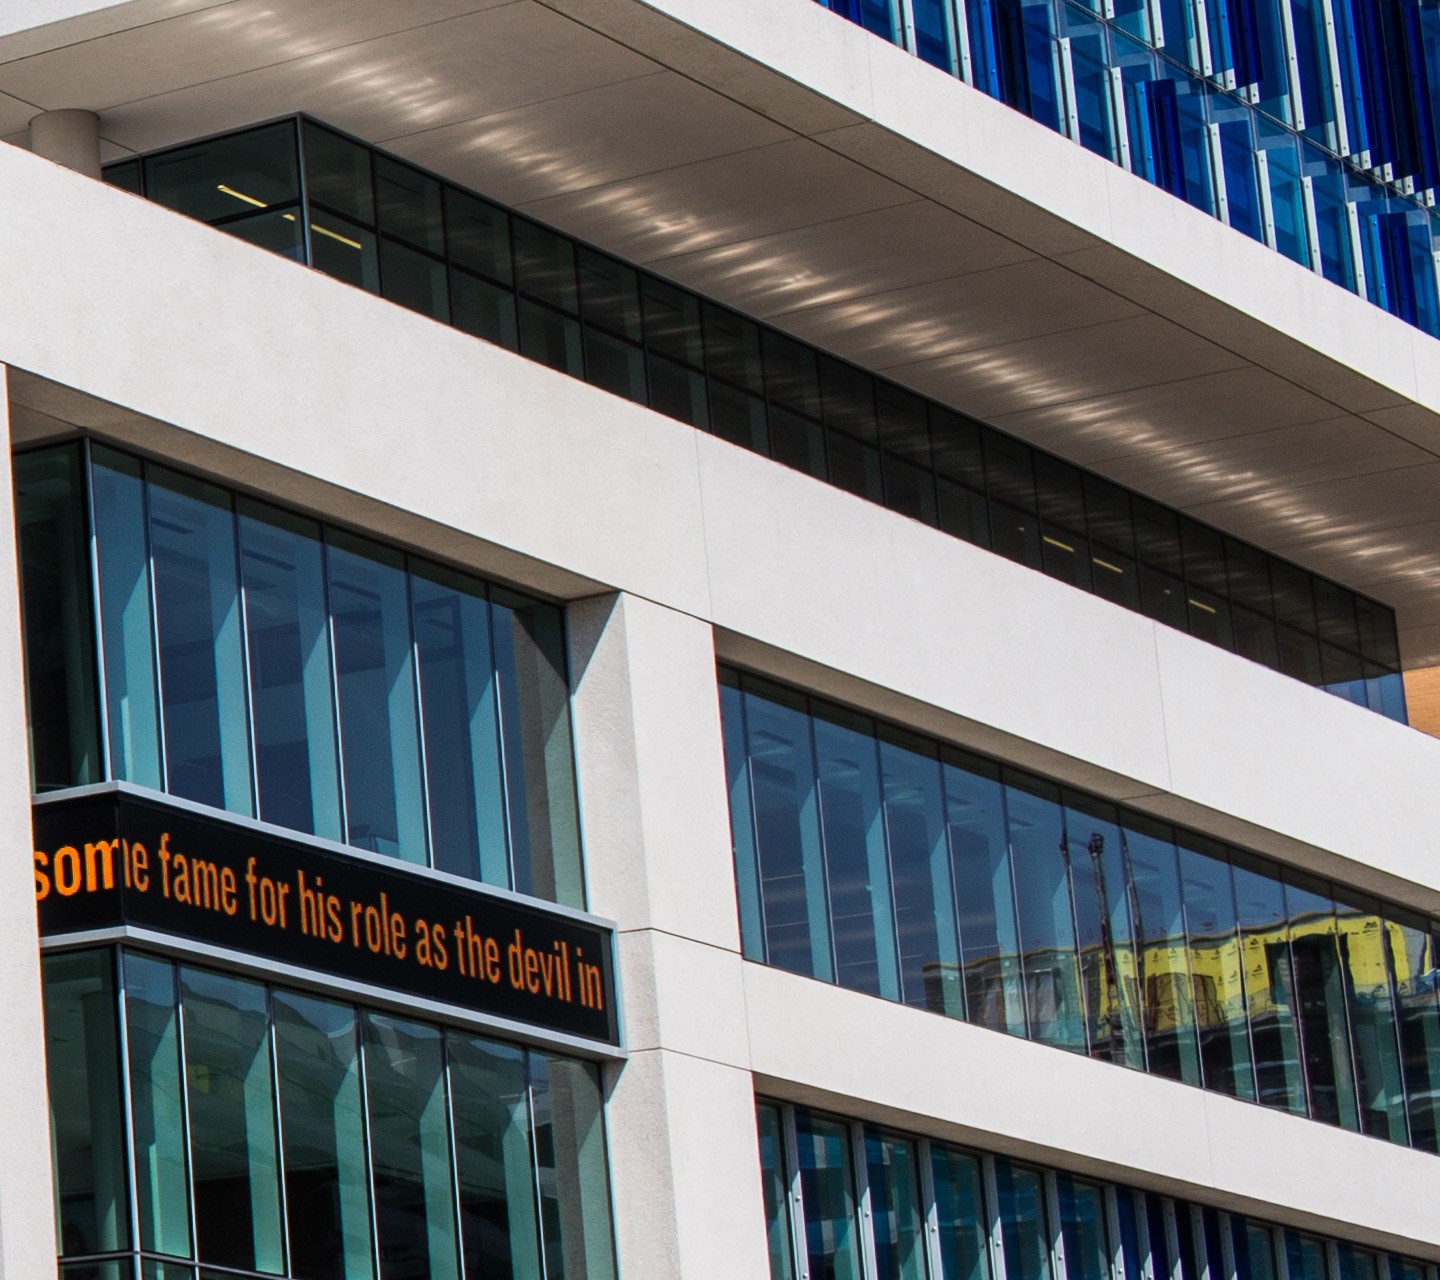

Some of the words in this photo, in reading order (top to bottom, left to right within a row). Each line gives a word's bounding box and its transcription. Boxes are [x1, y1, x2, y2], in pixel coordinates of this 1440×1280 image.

[160, 832, 238, 917] fame
[246, 856, 291, 929] for
[298, 868, 344, 945] his
[351, 891, 407, 961] role
[415, 916, 449, 971] as
[453, 917, 501, 985] the
[507, 928, 571, 1003] devil
[576, 945, 604, 1010] in
